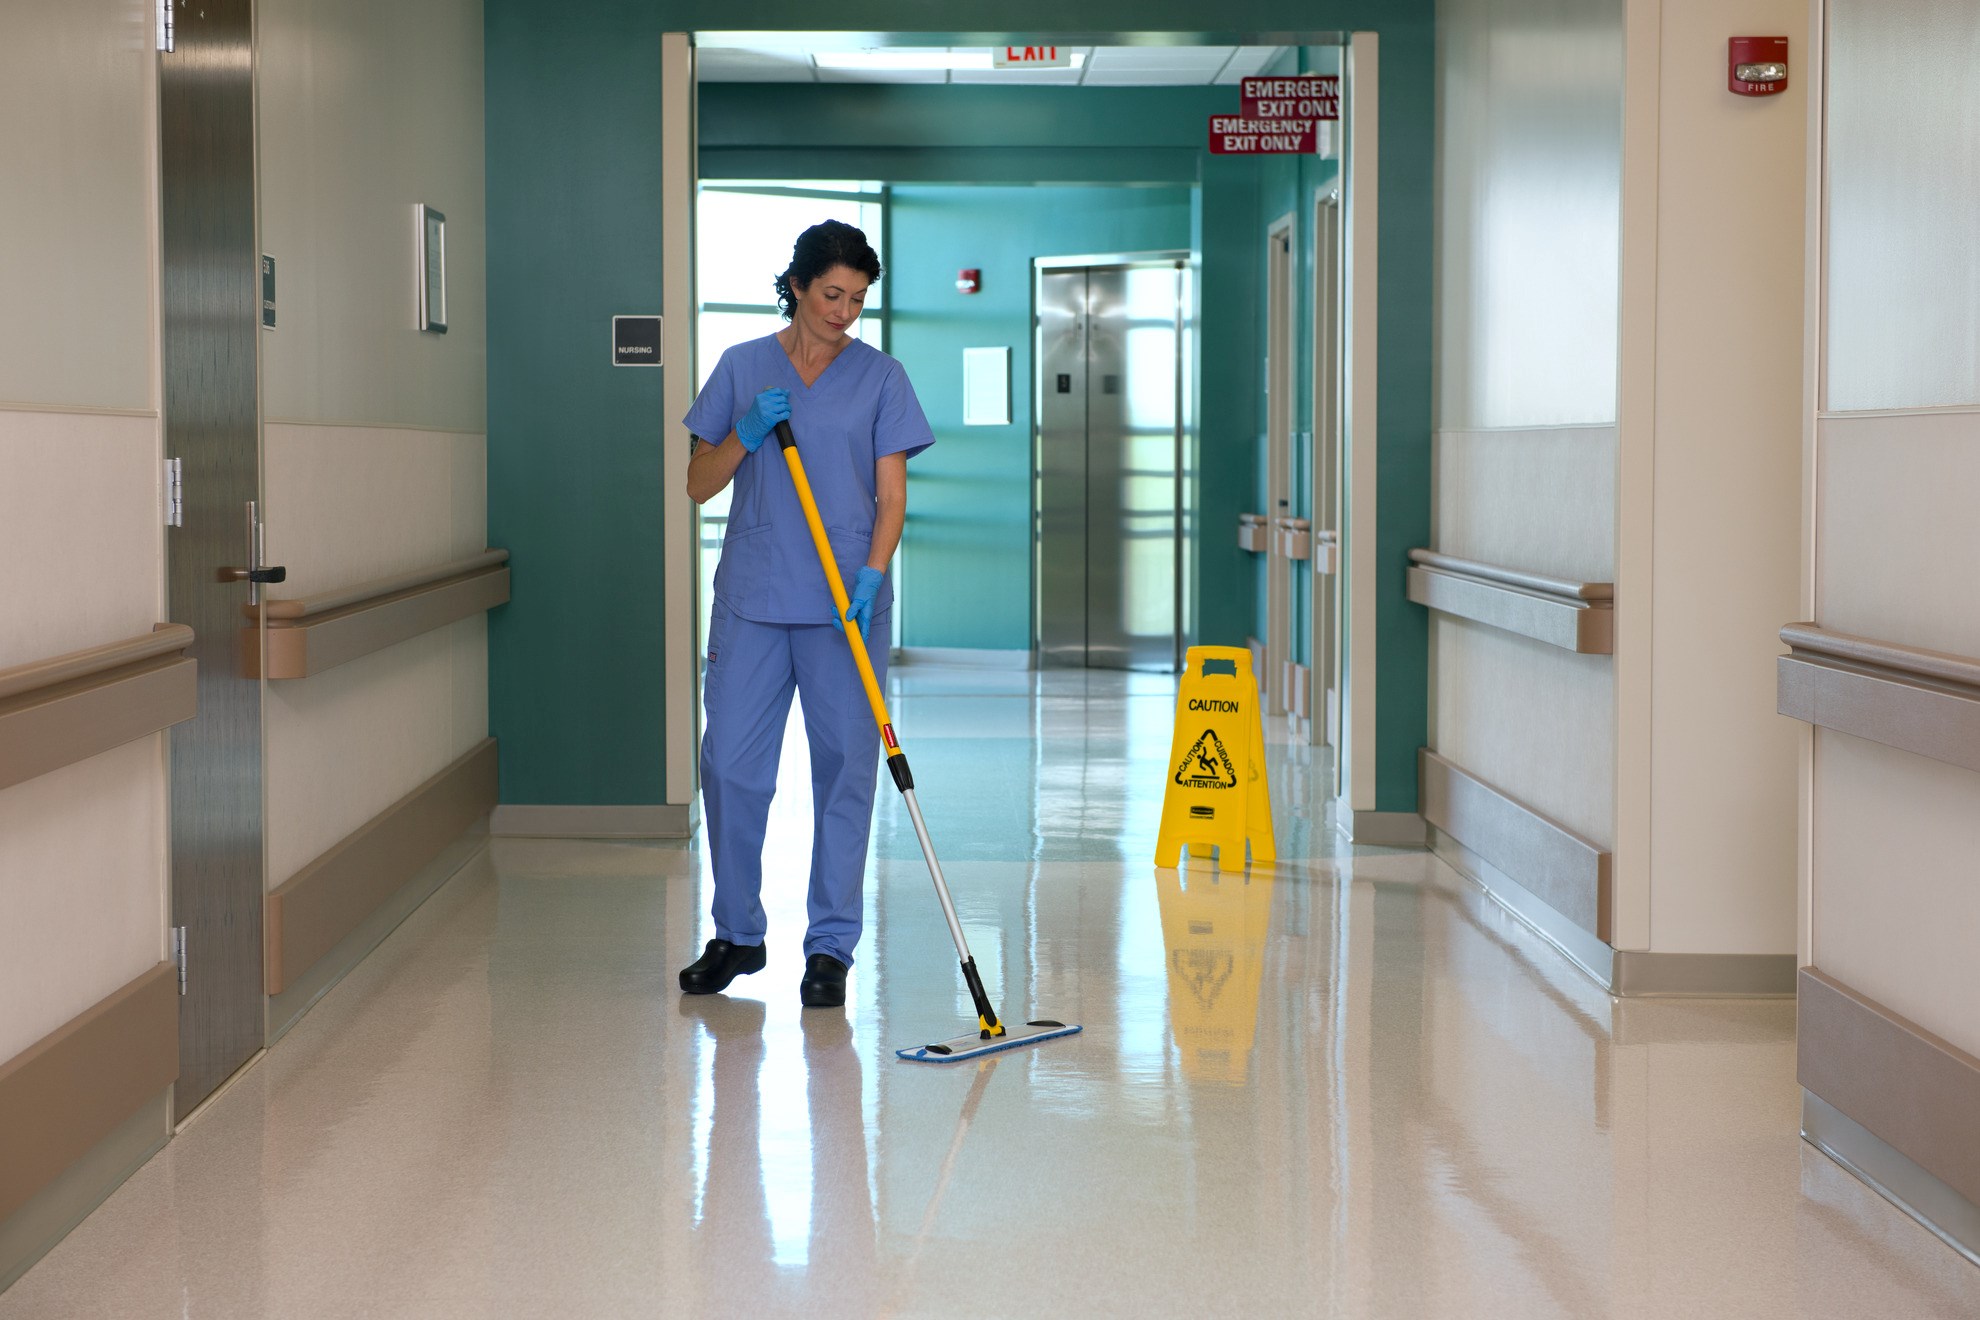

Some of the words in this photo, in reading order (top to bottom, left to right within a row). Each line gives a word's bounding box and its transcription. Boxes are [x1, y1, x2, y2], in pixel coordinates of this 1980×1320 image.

[1748, 83, 1774, 92] FIRE
[1257, 101, 1297, 117] EXIT
[1212, 118, 1313, 134] EMERGENCY
[1223, 135, 1258, 151] EXIT
[1260, 135, 1302, 151] ONLY
[618, 346, 652, 354] NURSING
[1188, 698, 1239, 713] CAUTION
[1178, 739, 1204, 773] CAUTION
[1214, 740, 1235, 776] CUIDADO
[1182, 779, 1227, 790] ATTENTION
